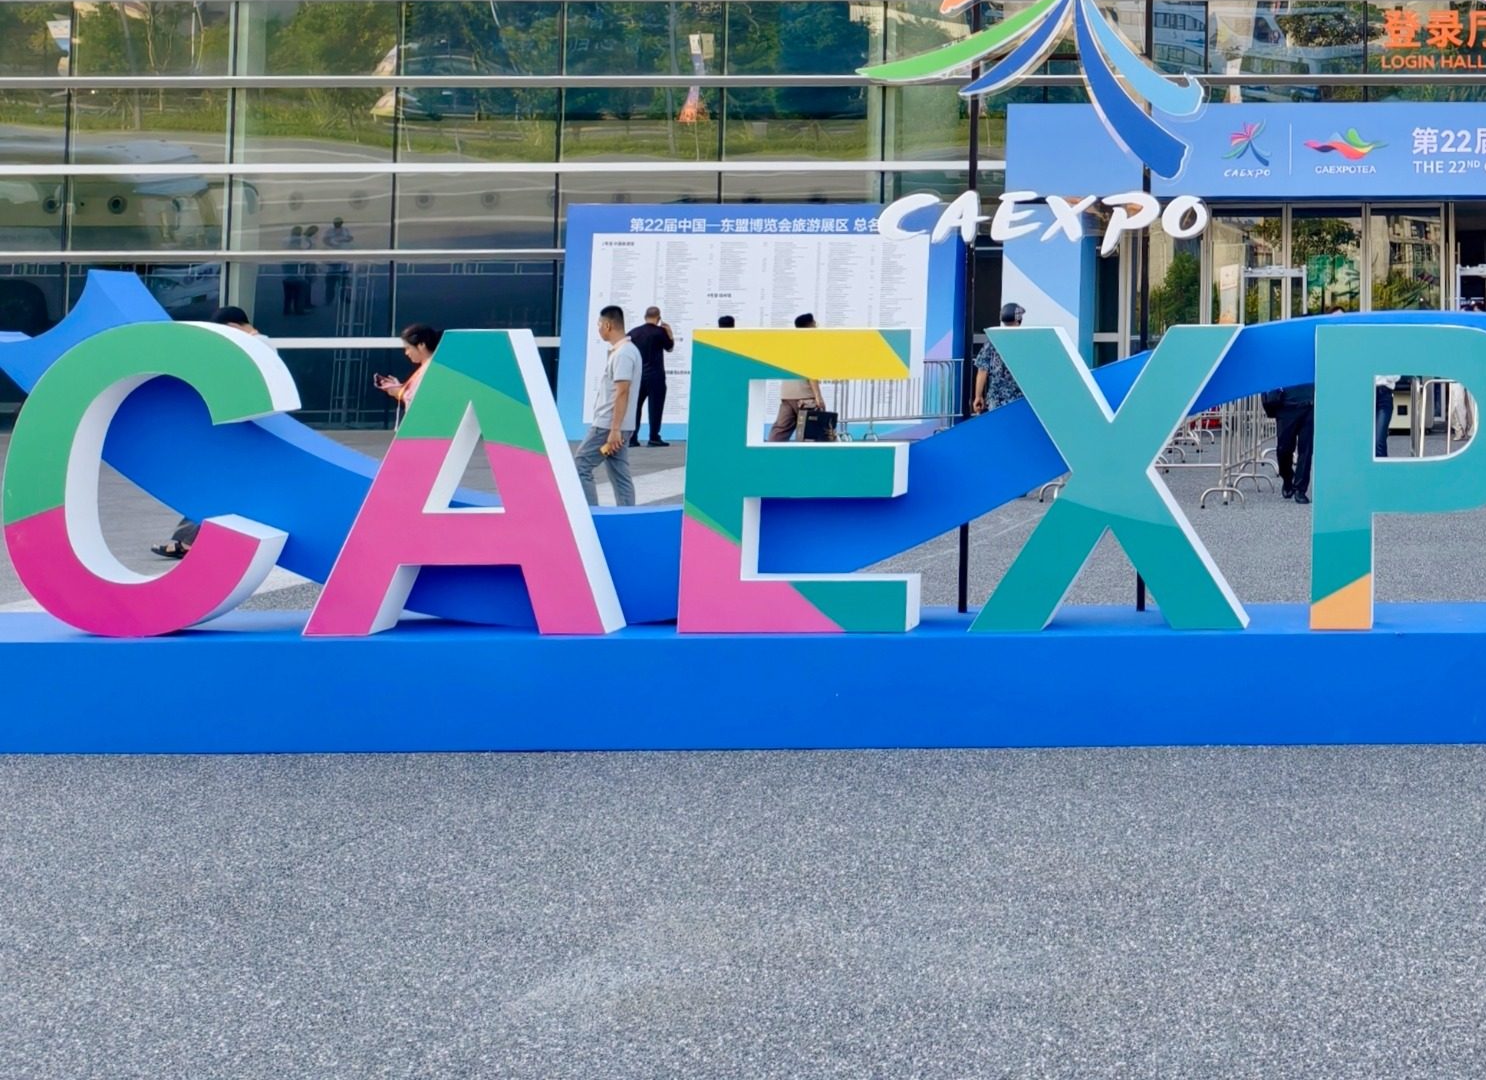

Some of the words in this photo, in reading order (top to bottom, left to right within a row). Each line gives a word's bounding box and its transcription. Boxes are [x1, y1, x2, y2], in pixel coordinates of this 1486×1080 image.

[1381, 55, 1435, 69] LOGIN
[1440, 55, 1486, 68] HALL
[1223, 168, 1272, 178] CAEXPO
[1314, 165, 1377, 174] CAEXPOTEA
[1413, 160, 1444, 173] THE
[1448, 160, 1481, 173] 22ND
[878, 190, 1208, 258] CAEXPO
